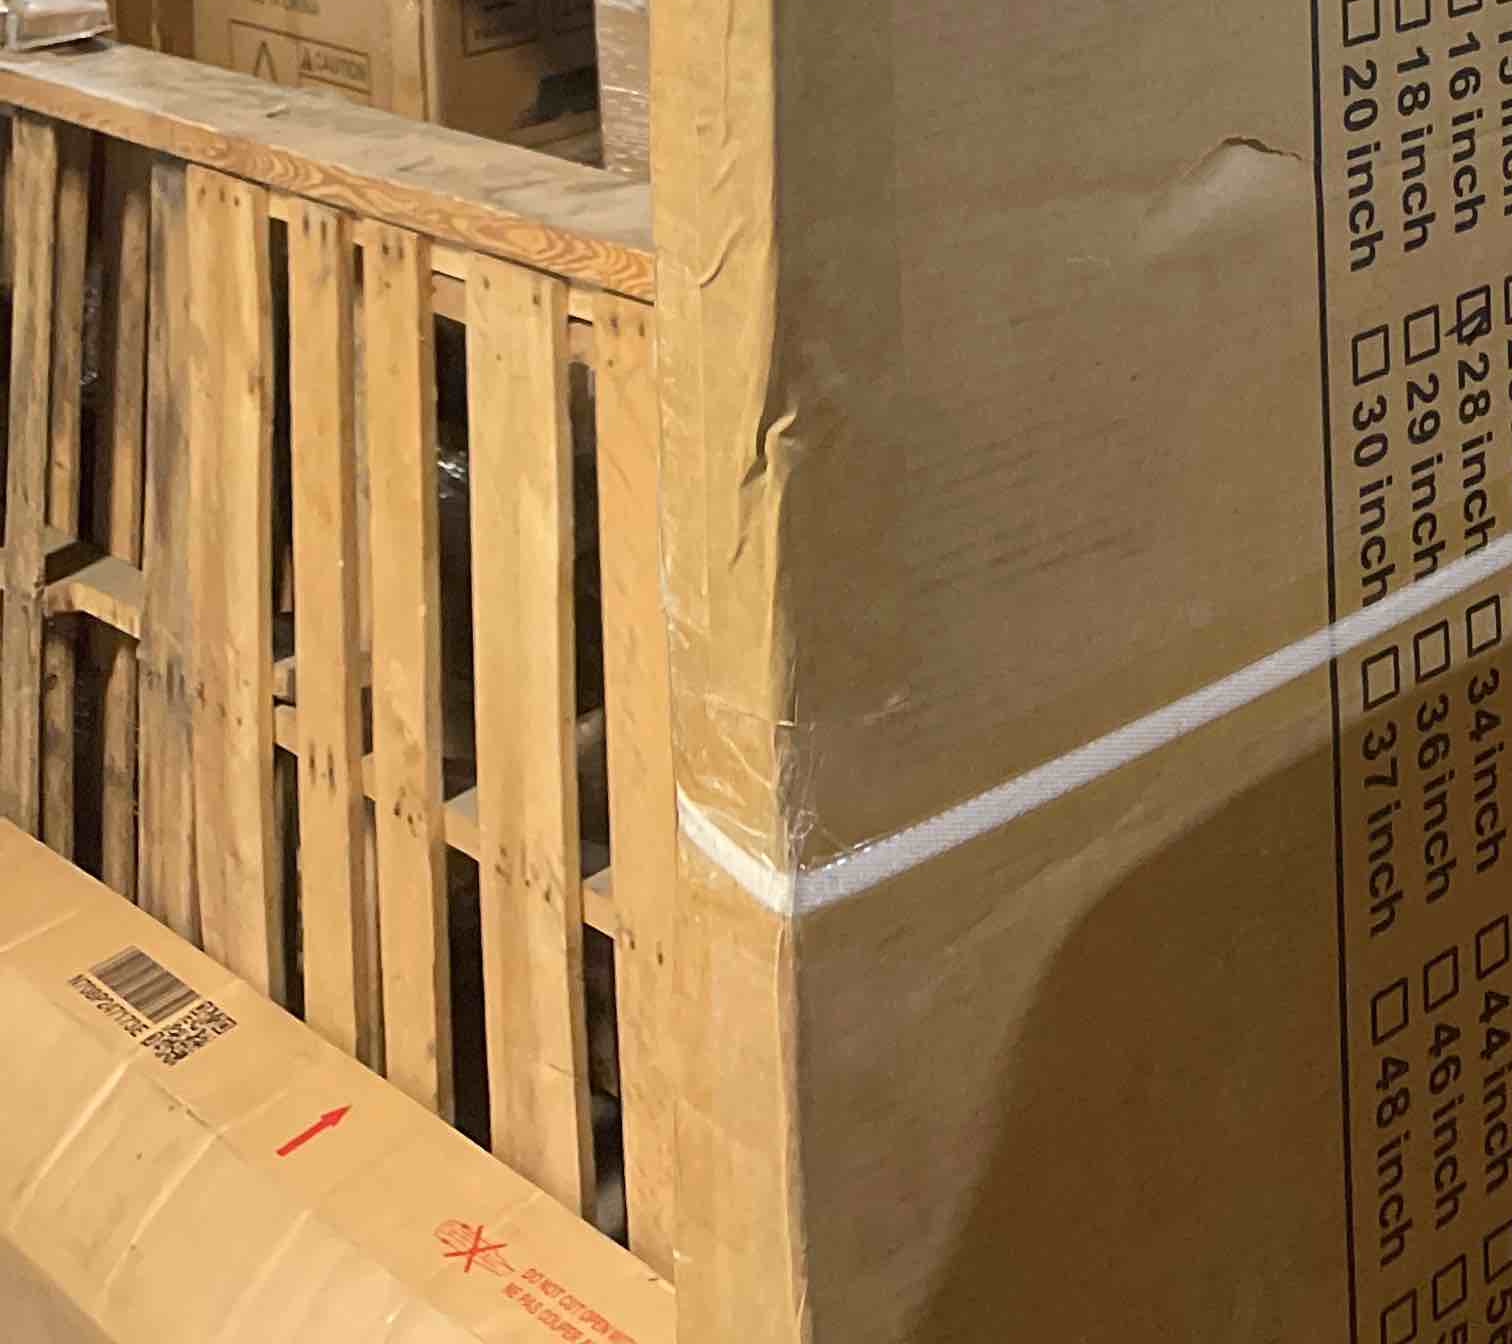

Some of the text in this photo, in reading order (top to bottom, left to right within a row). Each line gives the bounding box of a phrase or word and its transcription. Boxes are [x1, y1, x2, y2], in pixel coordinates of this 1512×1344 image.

[1342, 58, 1384, 273] 20 inch
[1396, 45, 1437, 253] 18 inch
[1447, 31, 1486, 234] 16 inch
[1352, 394, 1395, 609] 30 inch
[1406, 373, 1445, 581] 29 inch
[1456, 352, 1496, 558] 28 inch
[1361, 721, 1403, 938] 37 inch
[1375, 1056, 1413, 1271] 48 inch
[1428, 1023, 1466, 1231] 46 inch
